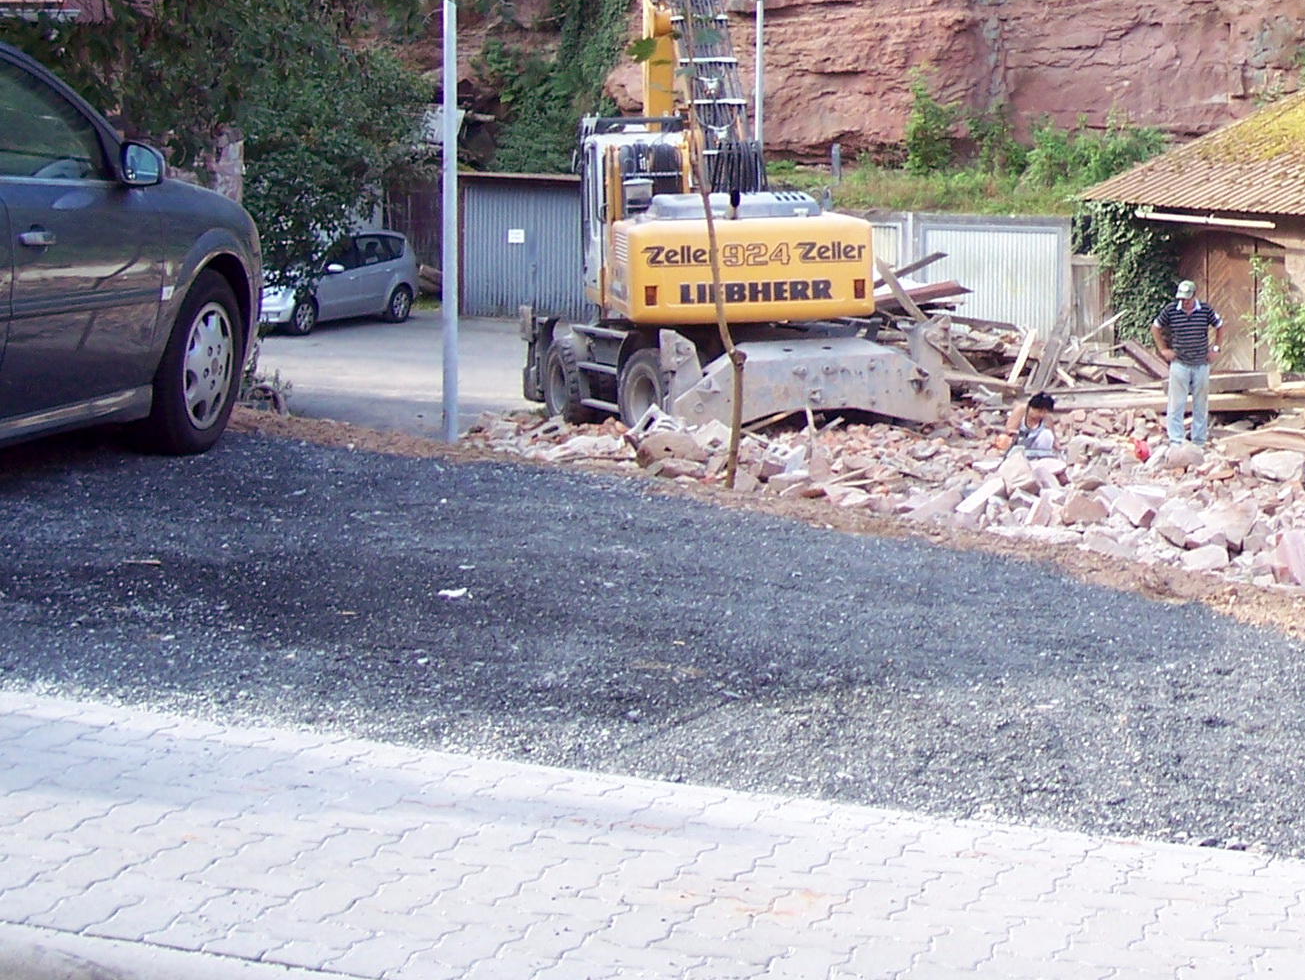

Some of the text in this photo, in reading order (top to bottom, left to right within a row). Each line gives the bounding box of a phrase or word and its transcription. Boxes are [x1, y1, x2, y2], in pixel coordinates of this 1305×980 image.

[723, 242, 791, 266] 924
[794, 241, 866, 263] Zeller
[680, 279, 832, 304] LIEBHERR
